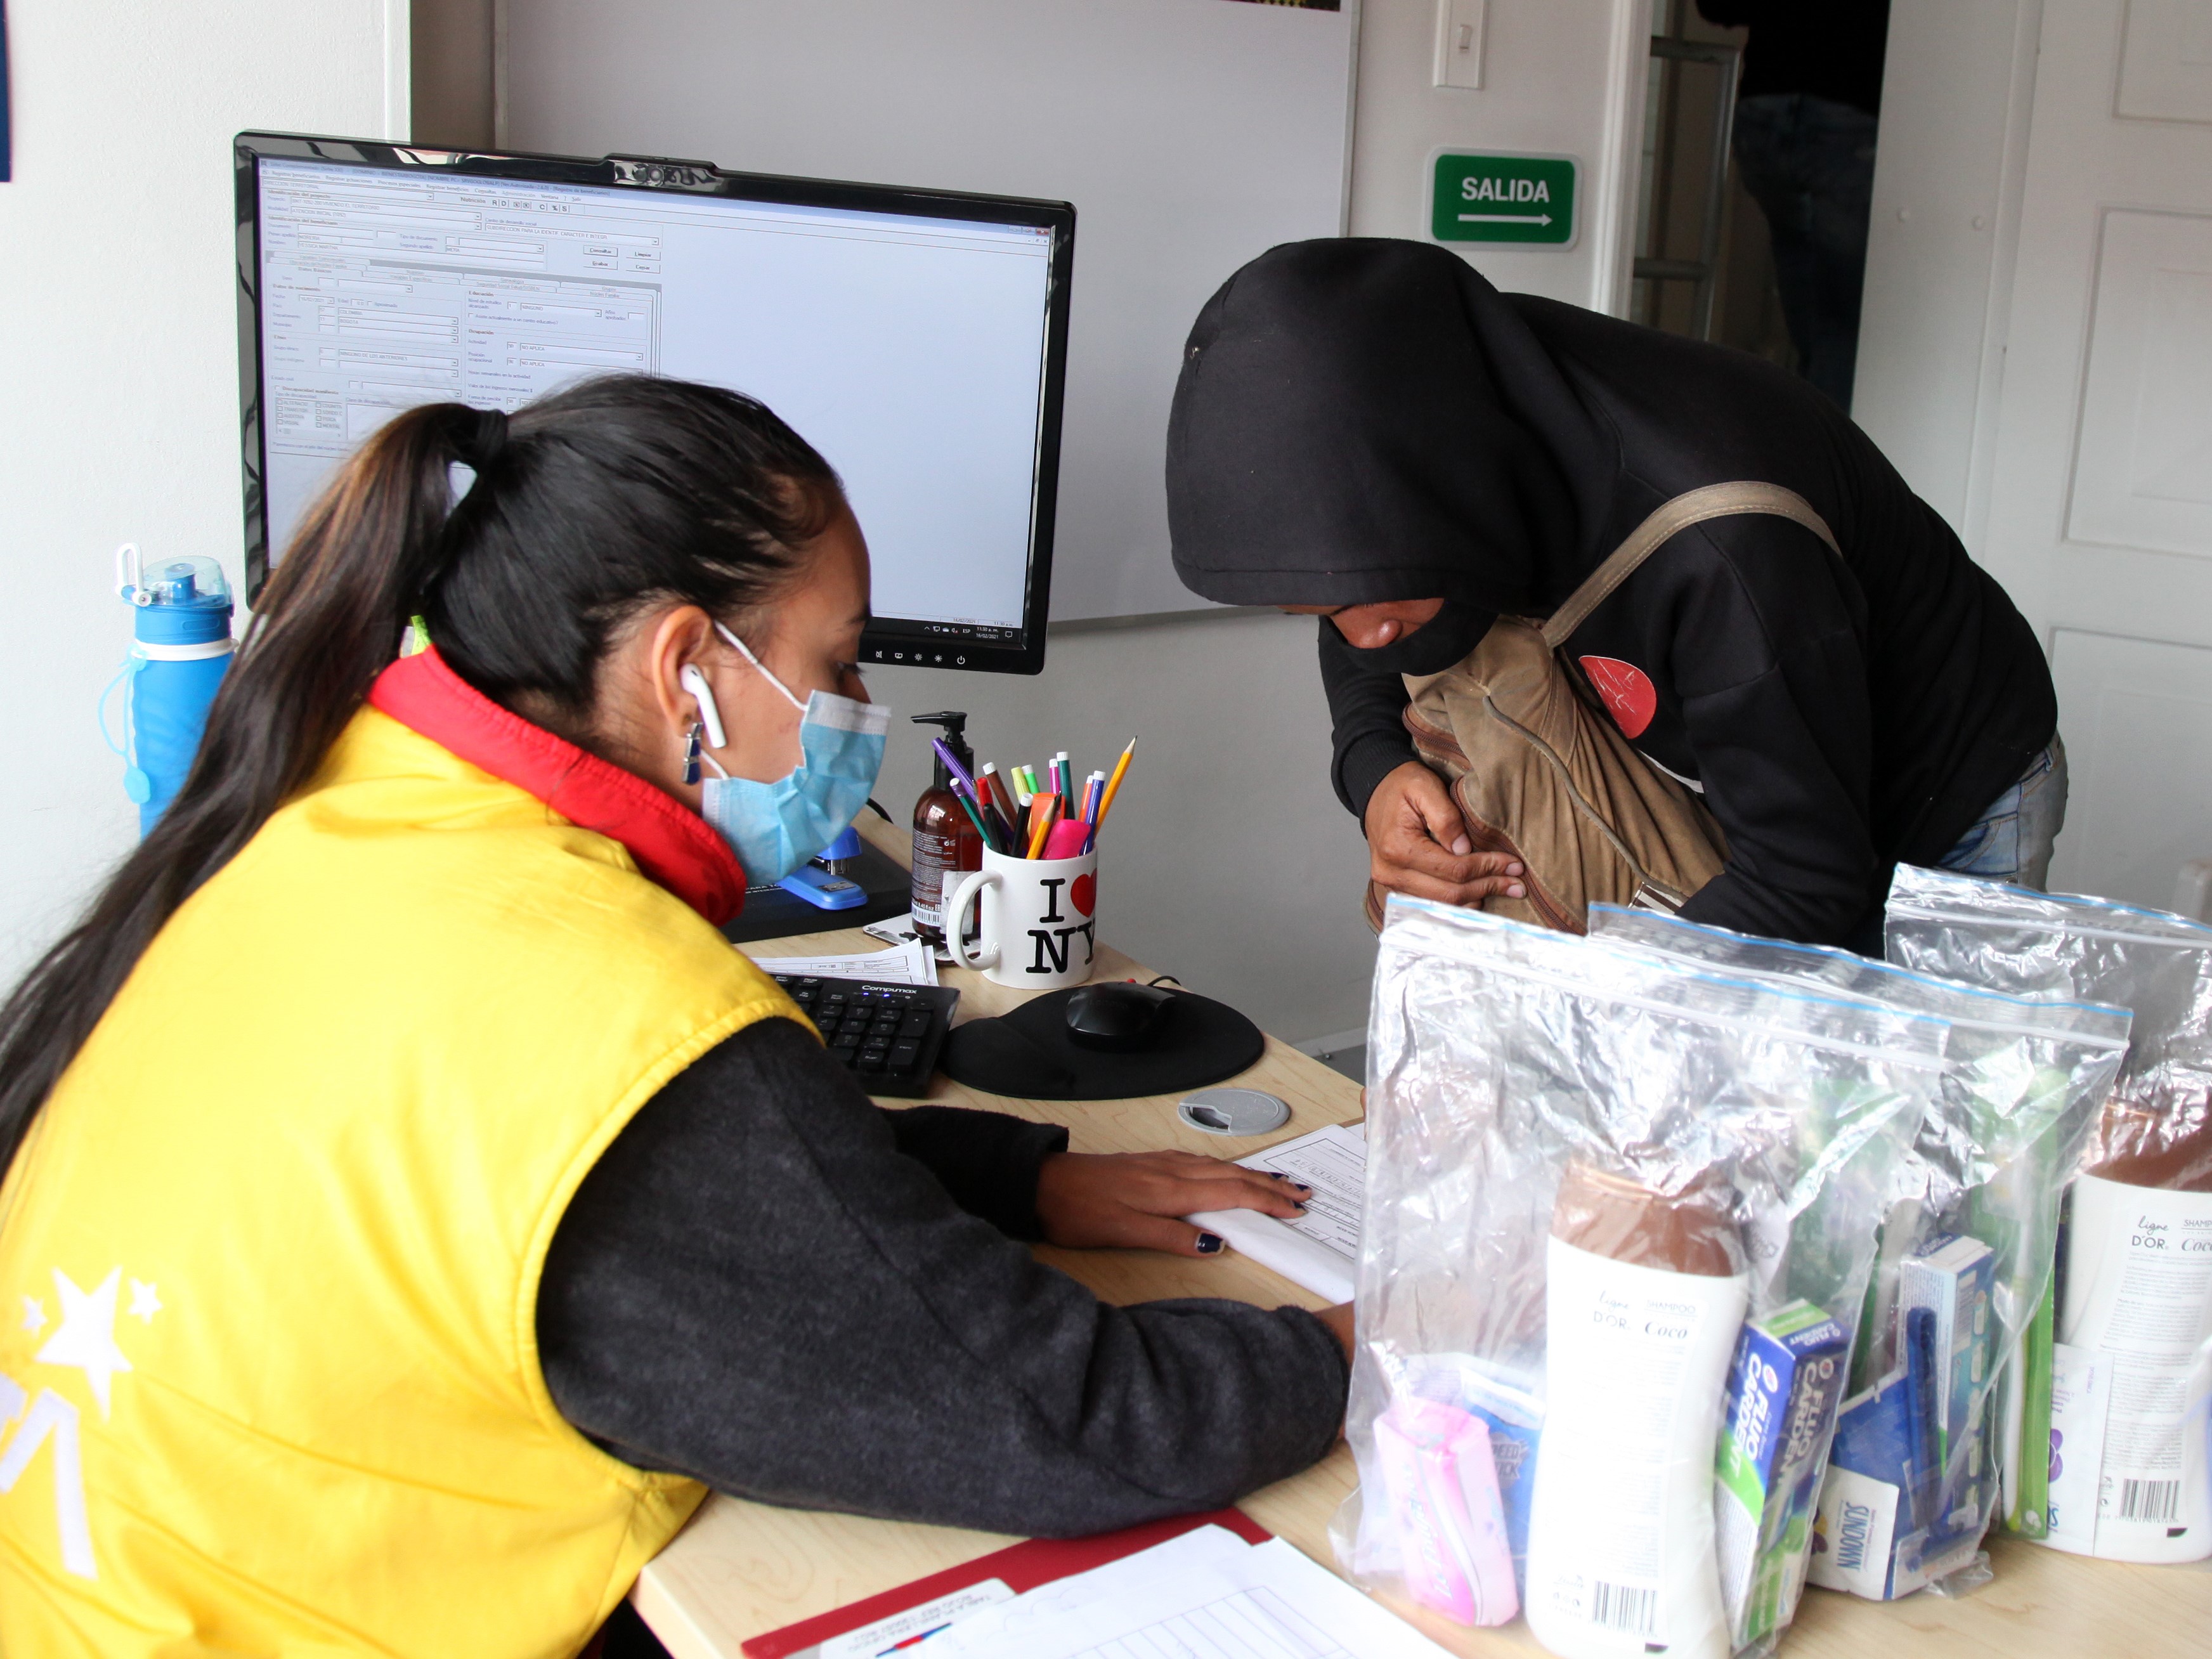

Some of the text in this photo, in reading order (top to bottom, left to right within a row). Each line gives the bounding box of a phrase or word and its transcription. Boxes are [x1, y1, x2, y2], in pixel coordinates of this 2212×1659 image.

[1461, 176, 1550, 203] SALIDA
[1039, 878, 1065, 923] I
[1025, 920, 1095, 973] NY
[862, 985, 917, 994] Compumax
[1644, 1320, 1688, 1339] Coco
[1647, 1300, 1696, 1314] SHAMPOO
[1729, 1353, 1762, 1478] CARDENT
[1745, 1389, 1769, 1461] FLUO
[1779, 1362, 1817, 1473] CARDEN
[1797, 1389, 1825, 1457] FLUO
[1837, 1501, 1870, 1572] SUNDOWN
